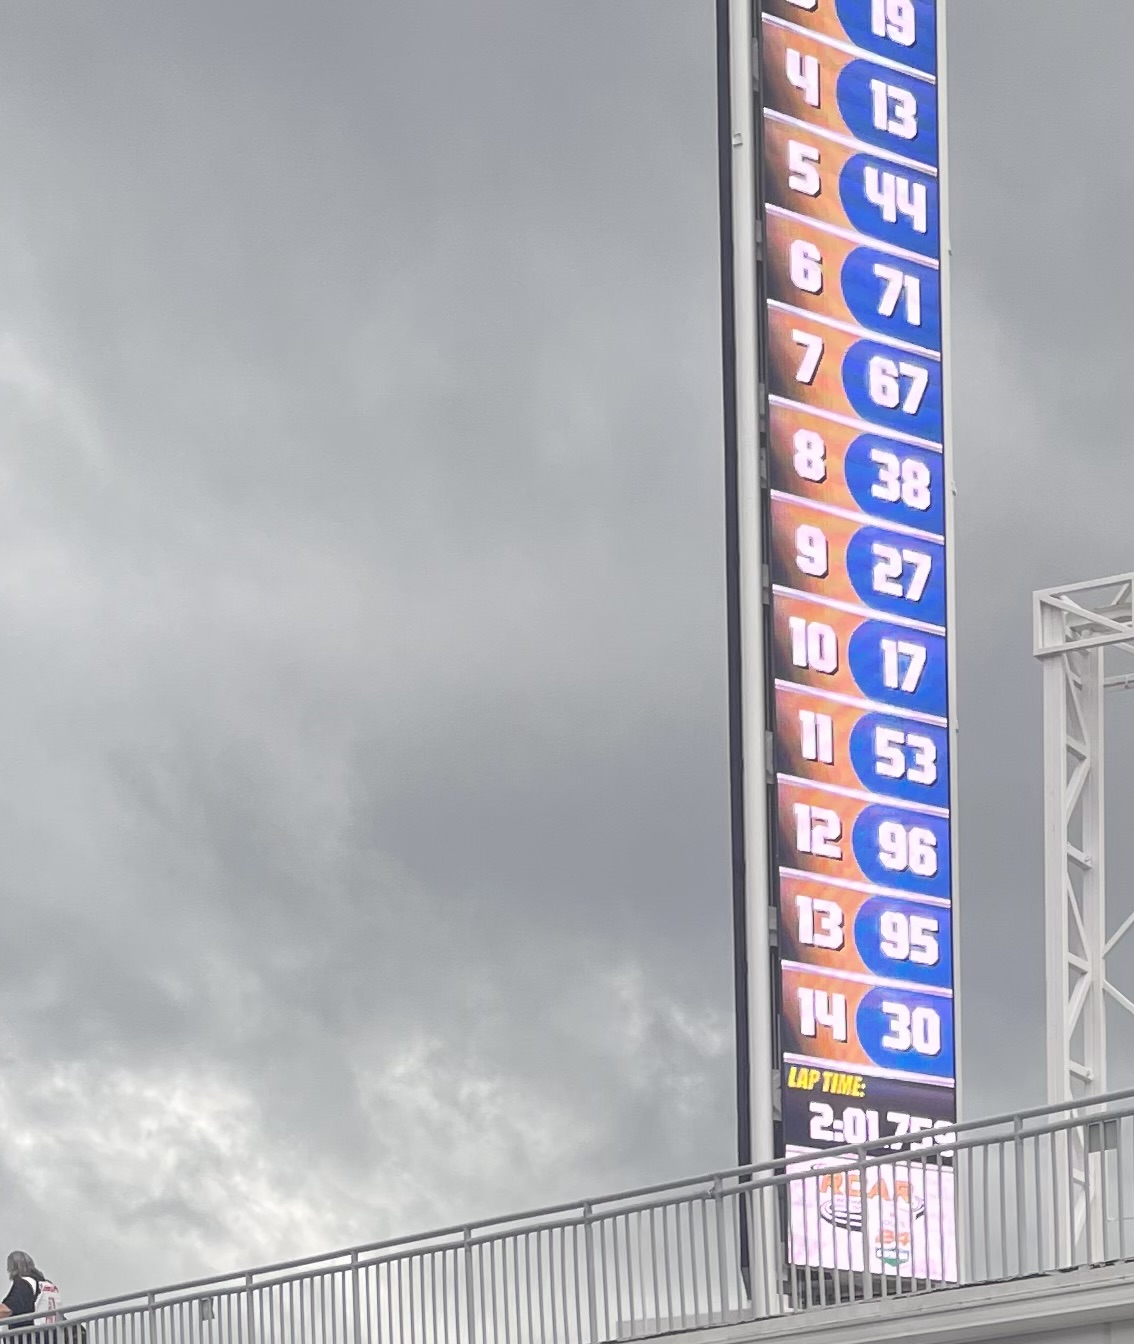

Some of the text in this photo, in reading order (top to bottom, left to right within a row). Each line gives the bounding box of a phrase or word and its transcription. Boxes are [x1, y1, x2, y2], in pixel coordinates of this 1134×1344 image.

[872, 0, 915, 45] 19
[786, 48, 916, 139] 4 13
[788, 140, 926, 232] 5 44
[790, 240, 920, 325] 6 71
[792, 329, 928, 413] 7 67
[793, 429, 930, 509] 8 38
[795, 524, 931, 601] 9 27
[789, 616, 926, 692] 10 17
[799, 710, 936, 784] 11 53
[793, 803, 936, 875] 12 96
[795, 895, 938, 965] 13 95
[797, 987, 940, 1055] 14 30
[788, 1066, 866, 1097] LAP TIME:
